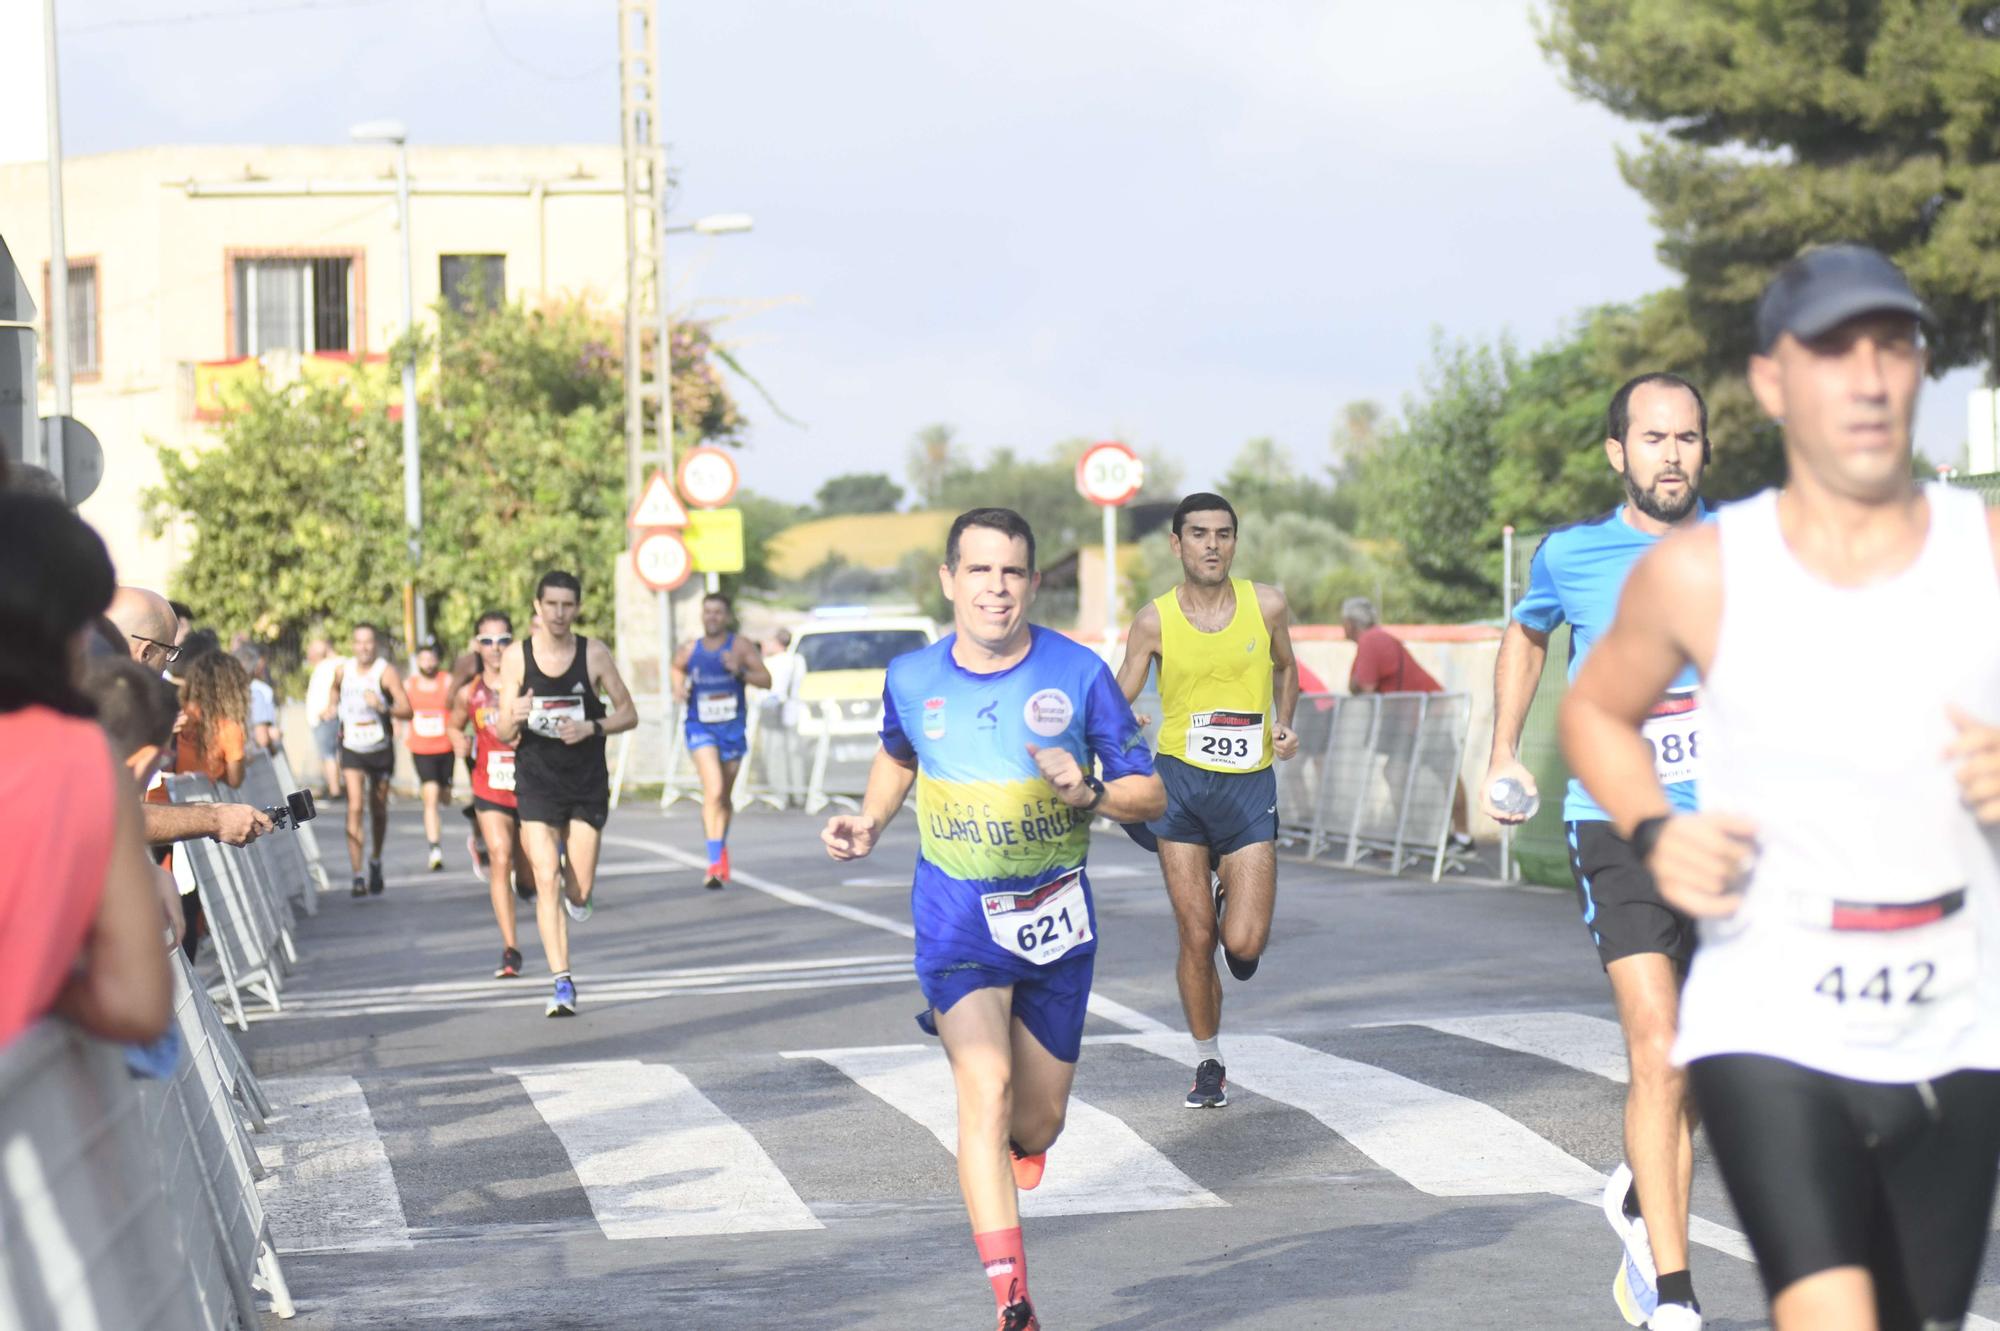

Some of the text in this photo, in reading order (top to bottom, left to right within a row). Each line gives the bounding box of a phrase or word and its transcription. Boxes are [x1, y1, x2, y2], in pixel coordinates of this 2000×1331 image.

[1093, 463, 1127, 484] 30
[1201, 736, 1248, 757] 293
[986, 821, 1018, 846] DE
[1017, 906, 1073, 951] 621
[1814, 959, 1936, 1004] 442
